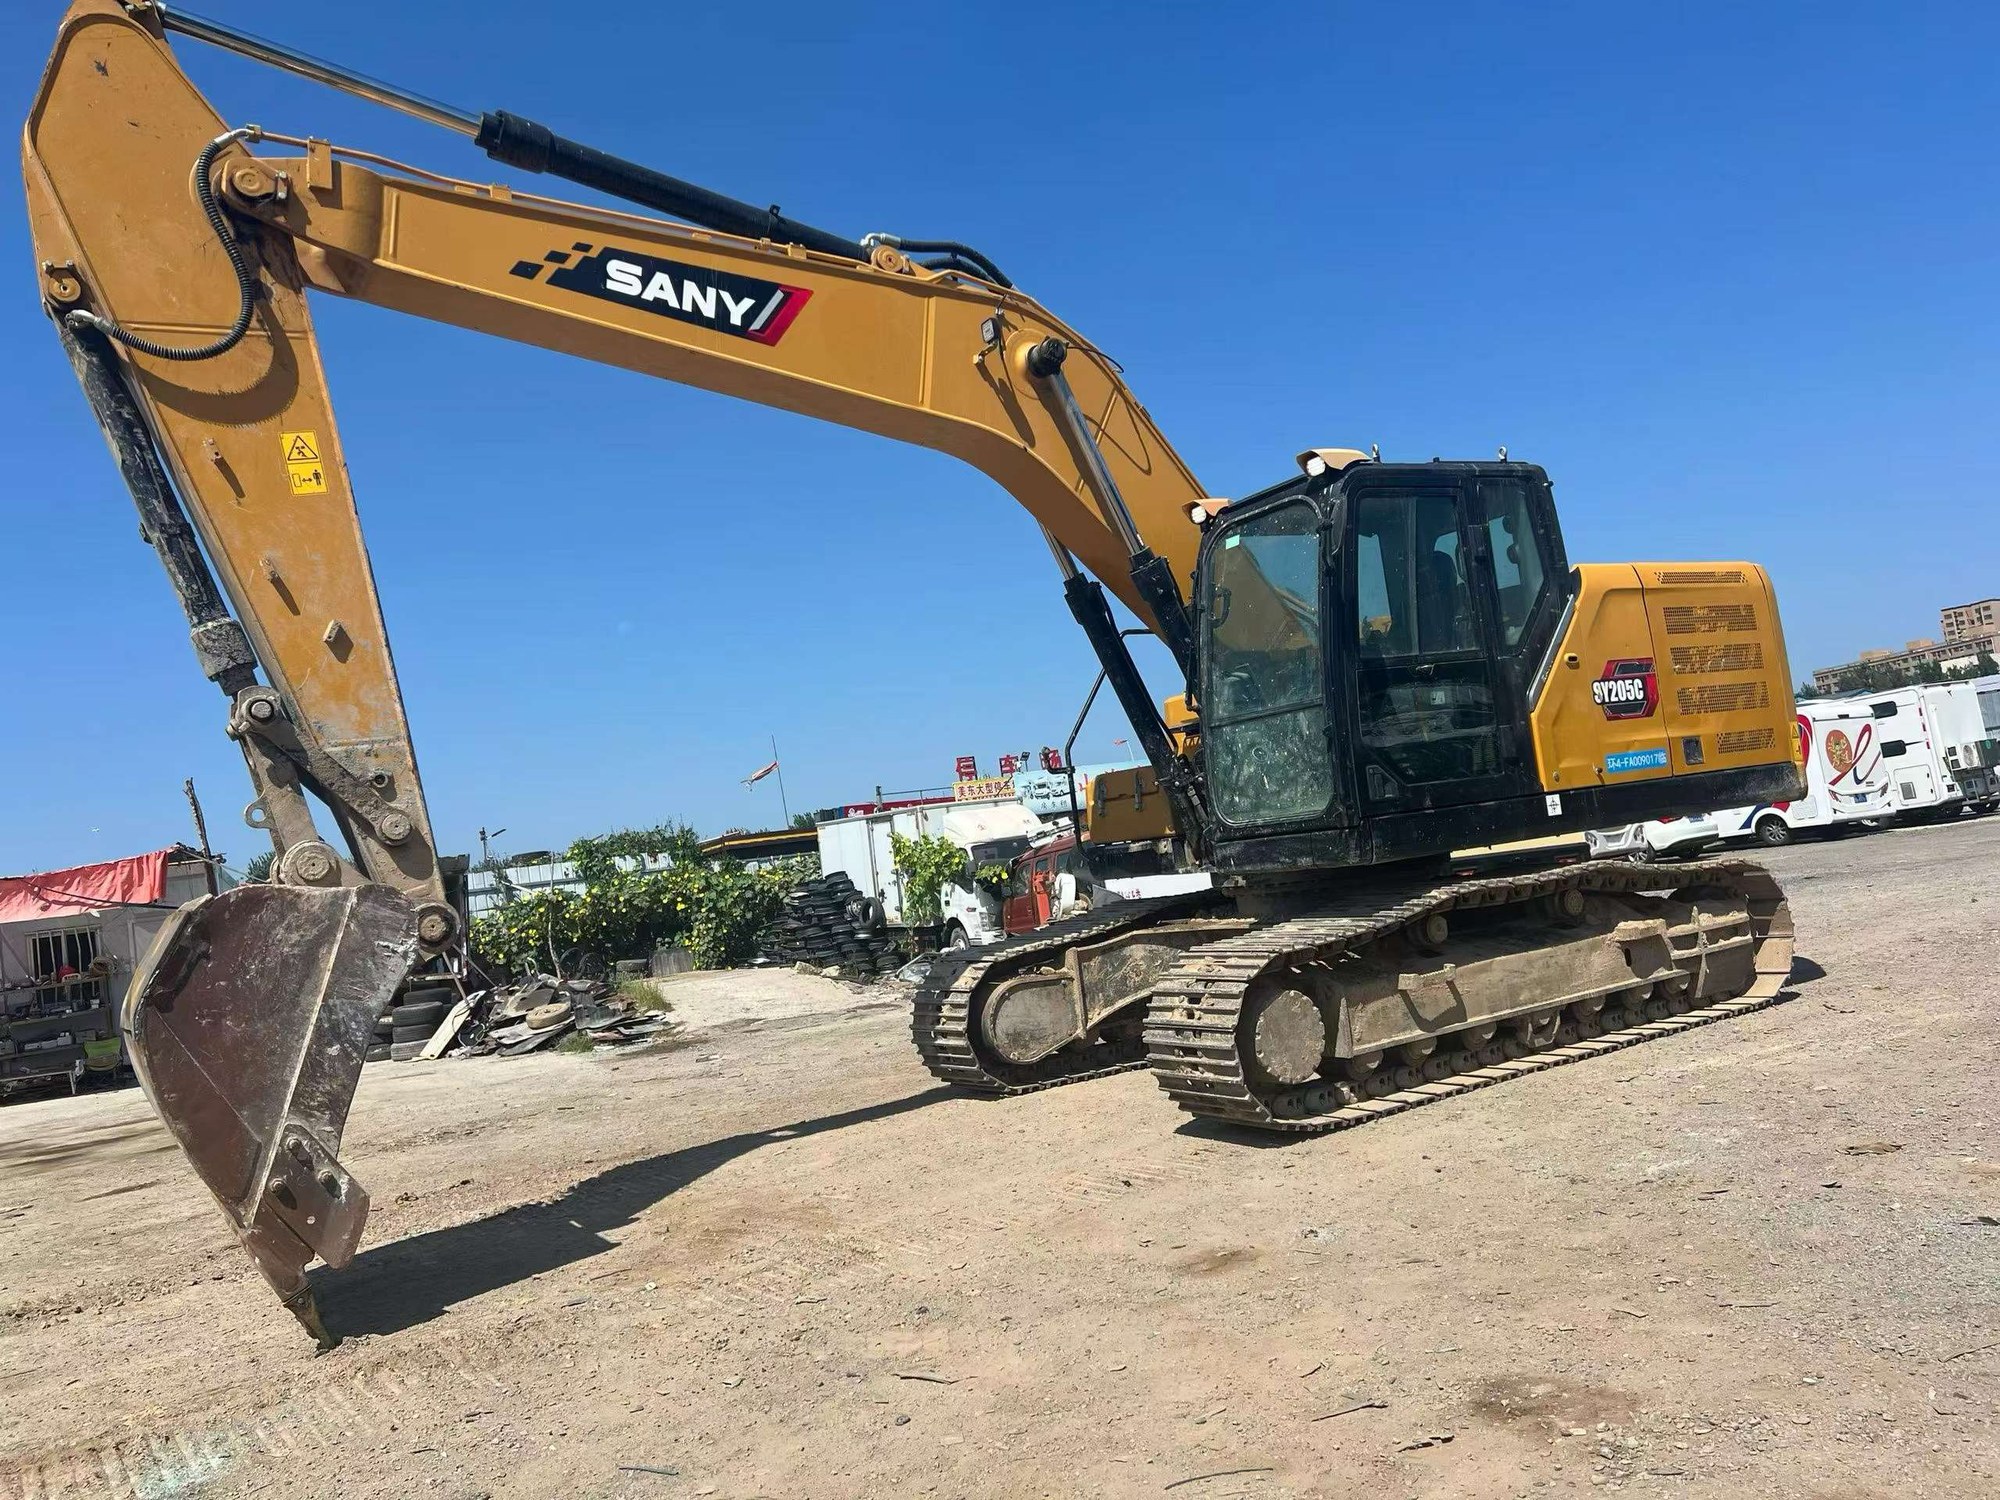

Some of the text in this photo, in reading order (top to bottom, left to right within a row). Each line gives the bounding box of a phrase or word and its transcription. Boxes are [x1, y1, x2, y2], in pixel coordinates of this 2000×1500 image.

[606, 259, 756, 327] SANY
[957, 780, 1016, 798] 美东大型停车
